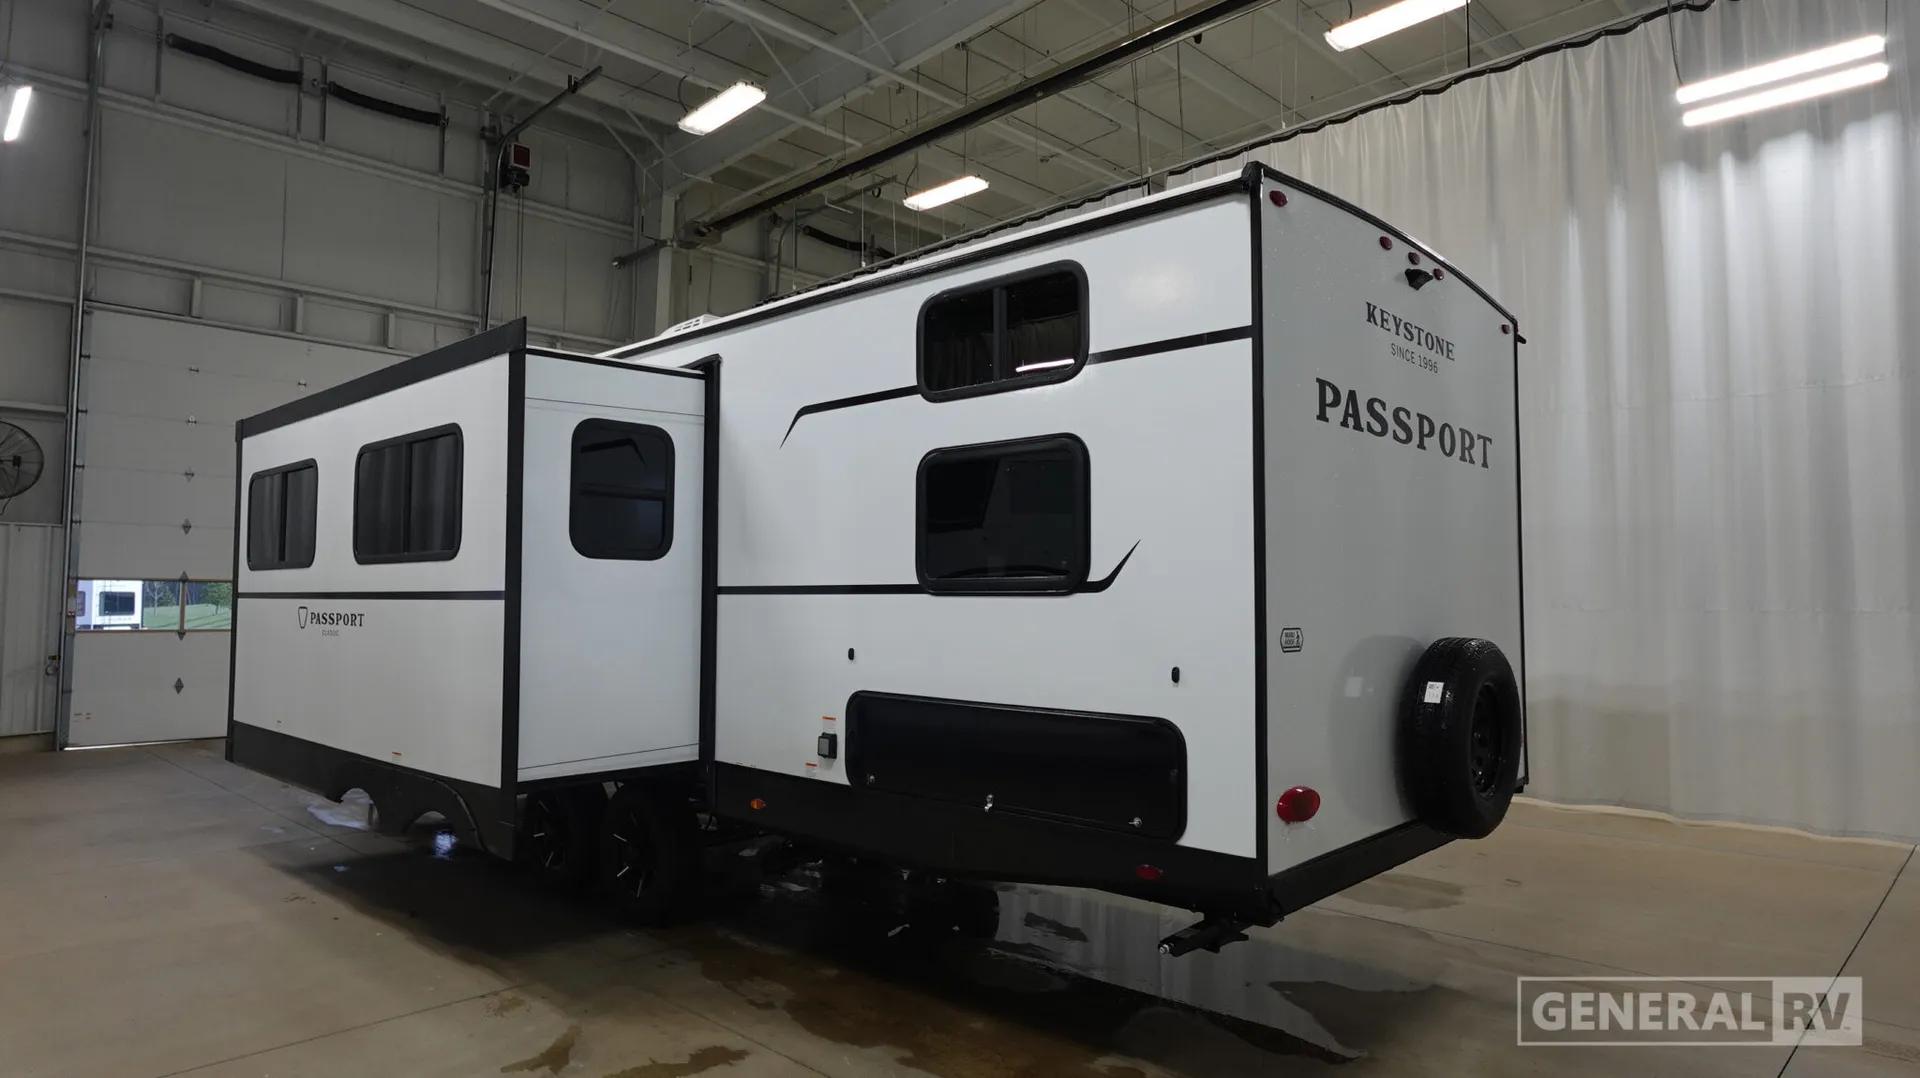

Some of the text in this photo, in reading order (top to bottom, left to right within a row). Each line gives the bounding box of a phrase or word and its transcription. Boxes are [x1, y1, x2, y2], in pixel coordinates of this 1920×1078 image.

[1366, 302, 1455, 361] KEYSTONE
[1391, 343, 1439, 374] SINCE 1996
[1316, 377, 1492, 468] PASSPORT
[310, 612, 365, 627] PASSPORT
